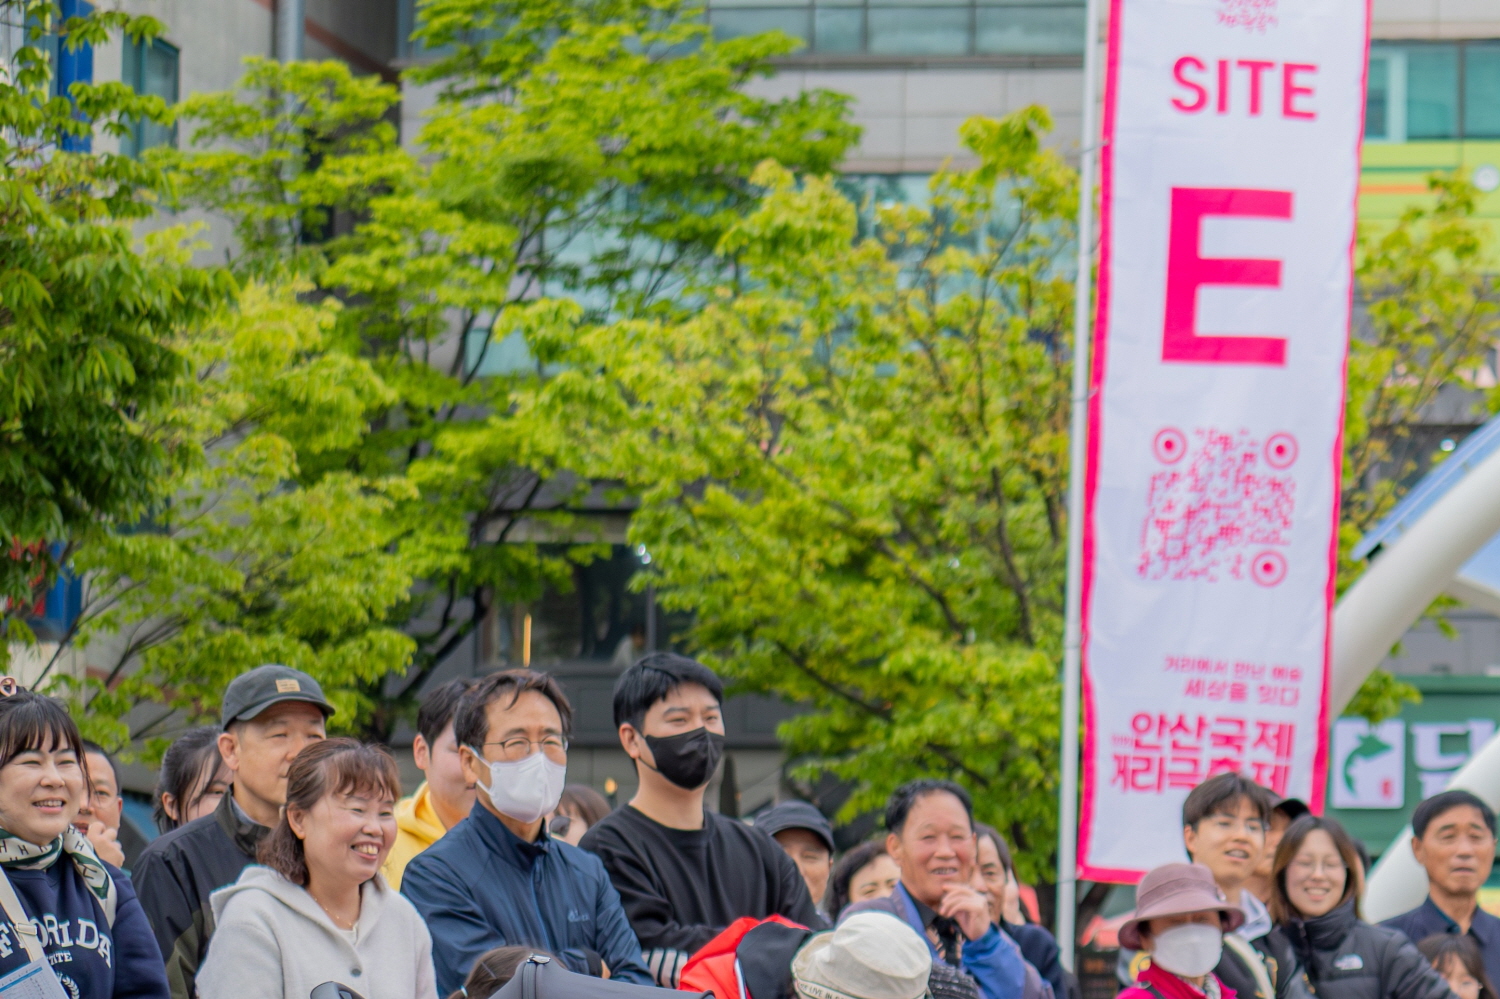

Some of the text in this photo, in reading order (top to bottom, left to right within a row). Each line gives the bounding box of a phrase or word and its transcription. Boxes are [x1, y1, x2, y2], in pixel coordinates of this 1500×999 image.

[1171, 55, 1318, 120] SITE
[1161, 187, 1294, 367] E
[1184, 678, 1248, 702] 세상을
[1130, 711, 1296, 761] 안산국제
[809, 985, 823, 998] LIVE
